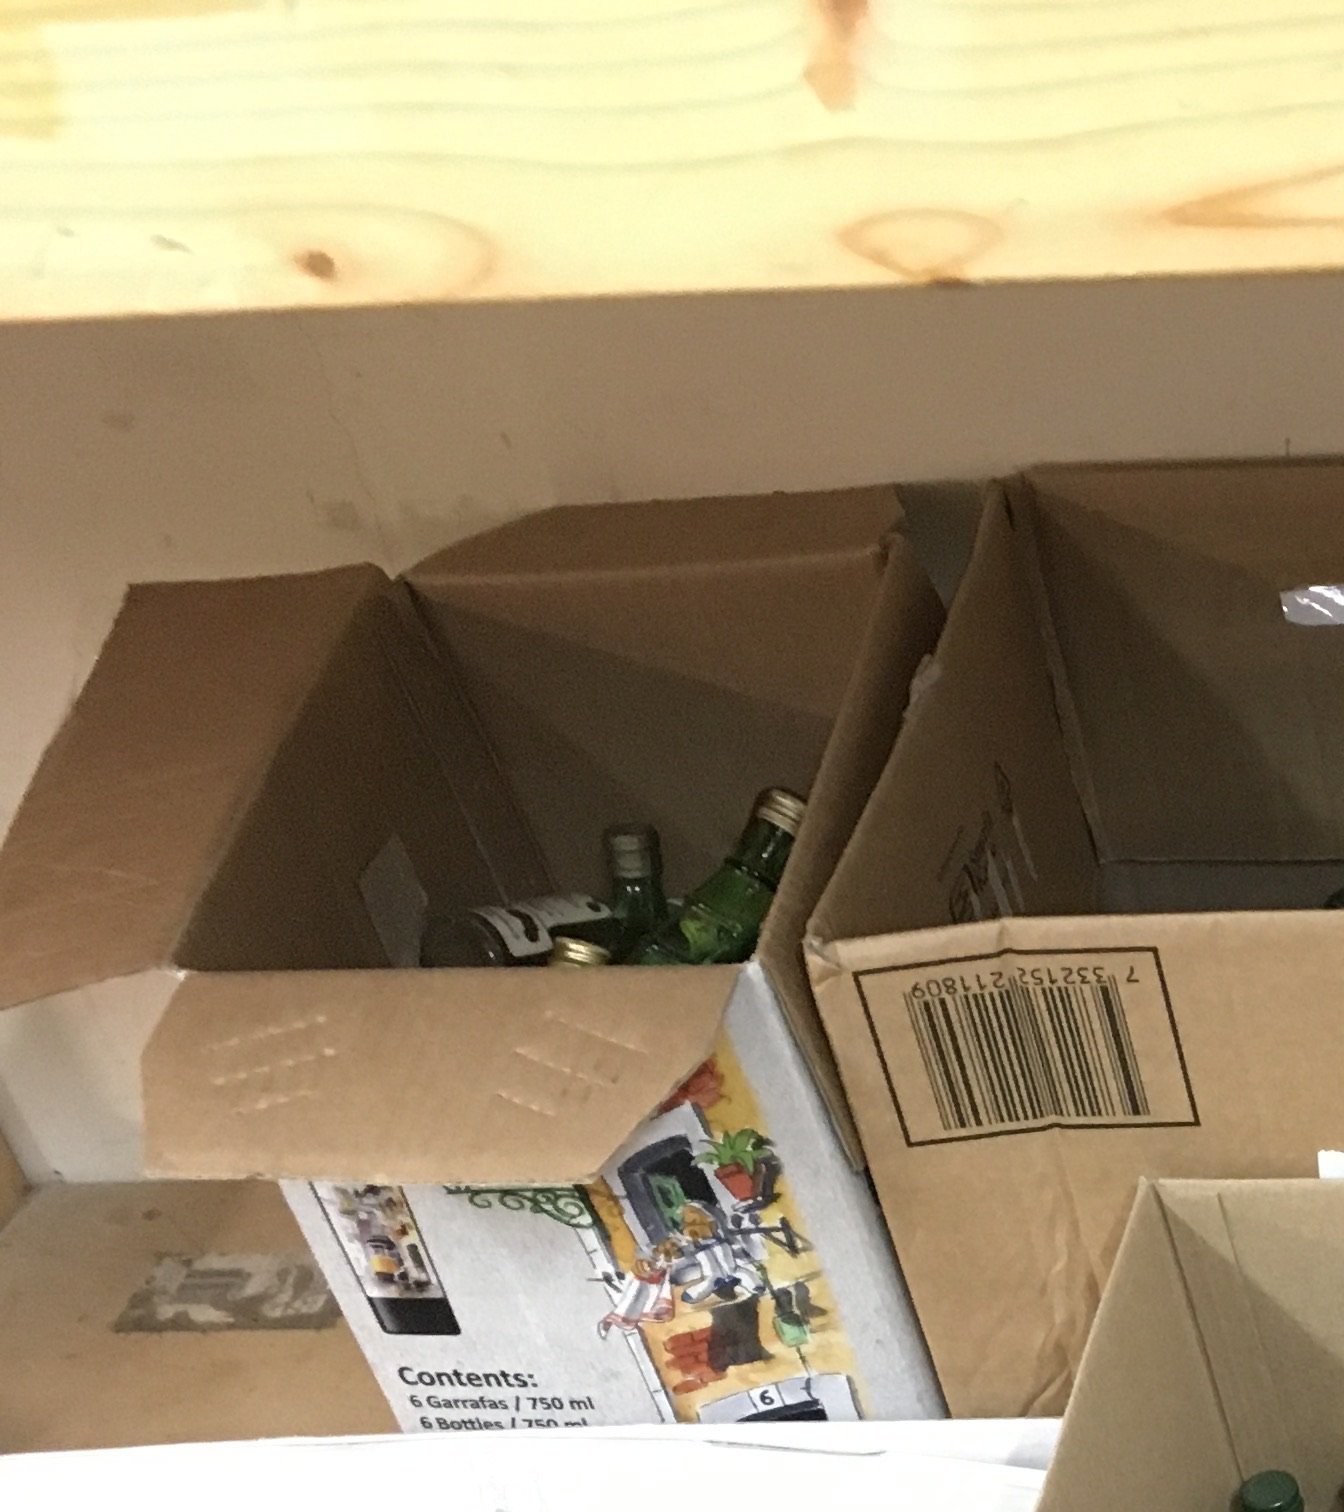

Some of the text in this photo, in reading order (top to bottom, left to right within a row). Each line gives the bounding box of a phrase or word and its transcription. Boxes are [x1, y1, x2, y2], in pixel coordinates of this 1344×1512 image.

[911, 965, 1140, 998] 7 332152 211809
[398, 1366, 538, 1388] Contents:
[410, 1395, 422, 1408] 6
[427, 1395, 508, 1410] Garrafas
[530, 1396, 563, 1410] 750
[569, 1396, 595, 1410] ml
[754, 1390, 774, 1406] 6
[420, 1416, 432, 1430] 6
